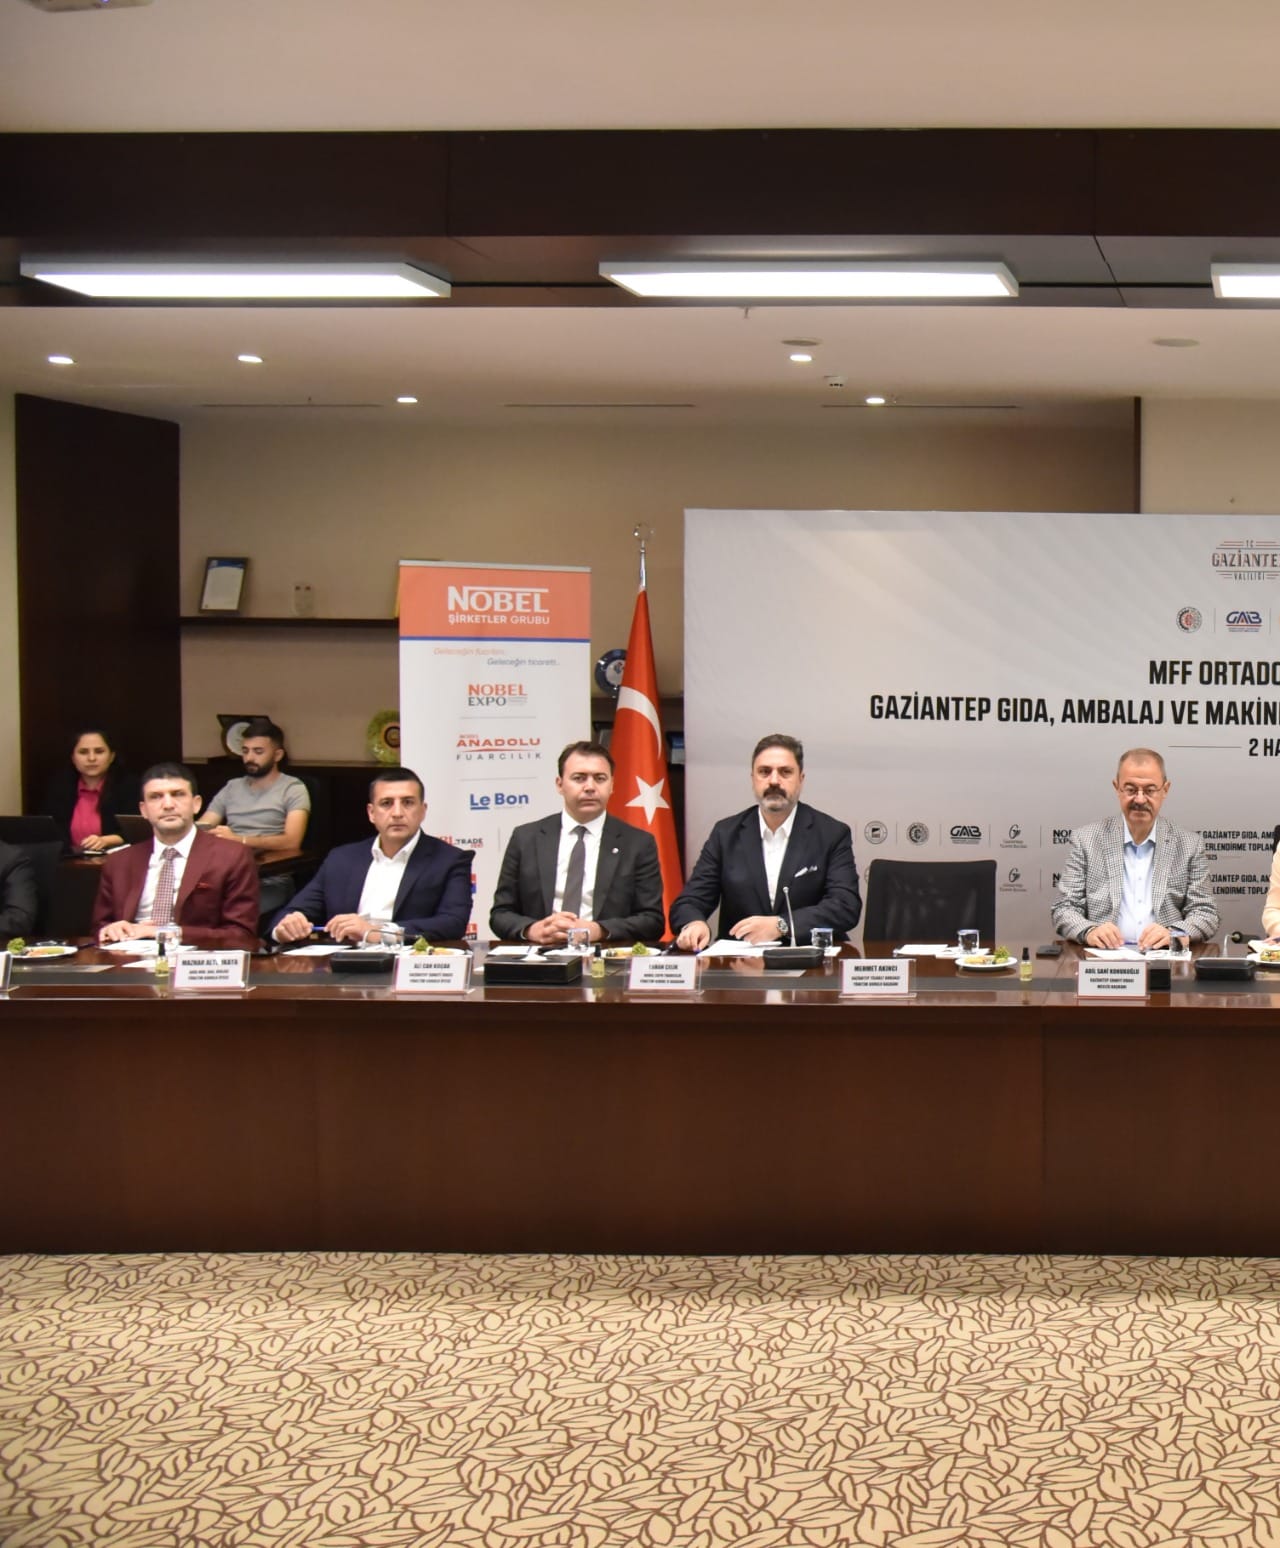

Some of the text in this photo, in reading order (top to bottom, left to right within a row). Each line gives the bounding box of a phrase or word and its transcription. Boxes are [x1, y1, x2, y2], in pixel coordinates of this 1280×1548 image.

[448, 586, 549, 613] NOBEL
[448, 614, 550, 625] ŞİRKETLER GRUBU
[1149, 661, 1193, 685] MFF
[468, 684, 528, 696] NOBEL
[468, 697, 507, 707] EXPO
[870, 691, 990, 721] GAZİANTEP
[998, 698, 1055, 726] GIDA,
[1061, 699, 1164, 725] AMBALAJ
[1170, 700, 1199, 725] VE
[456, 738, 541, 748] ANADOLU
[1249, 739, 1258, 757] 2
[470, 792, 529, 807] Le Bon
[1203, 829, 1240, 839] GAZİANTEP
[1205, 842, 1274, 851] ERLENDİRME TOPLAN
[1213, 886, 1246, 894] LENDİRME
